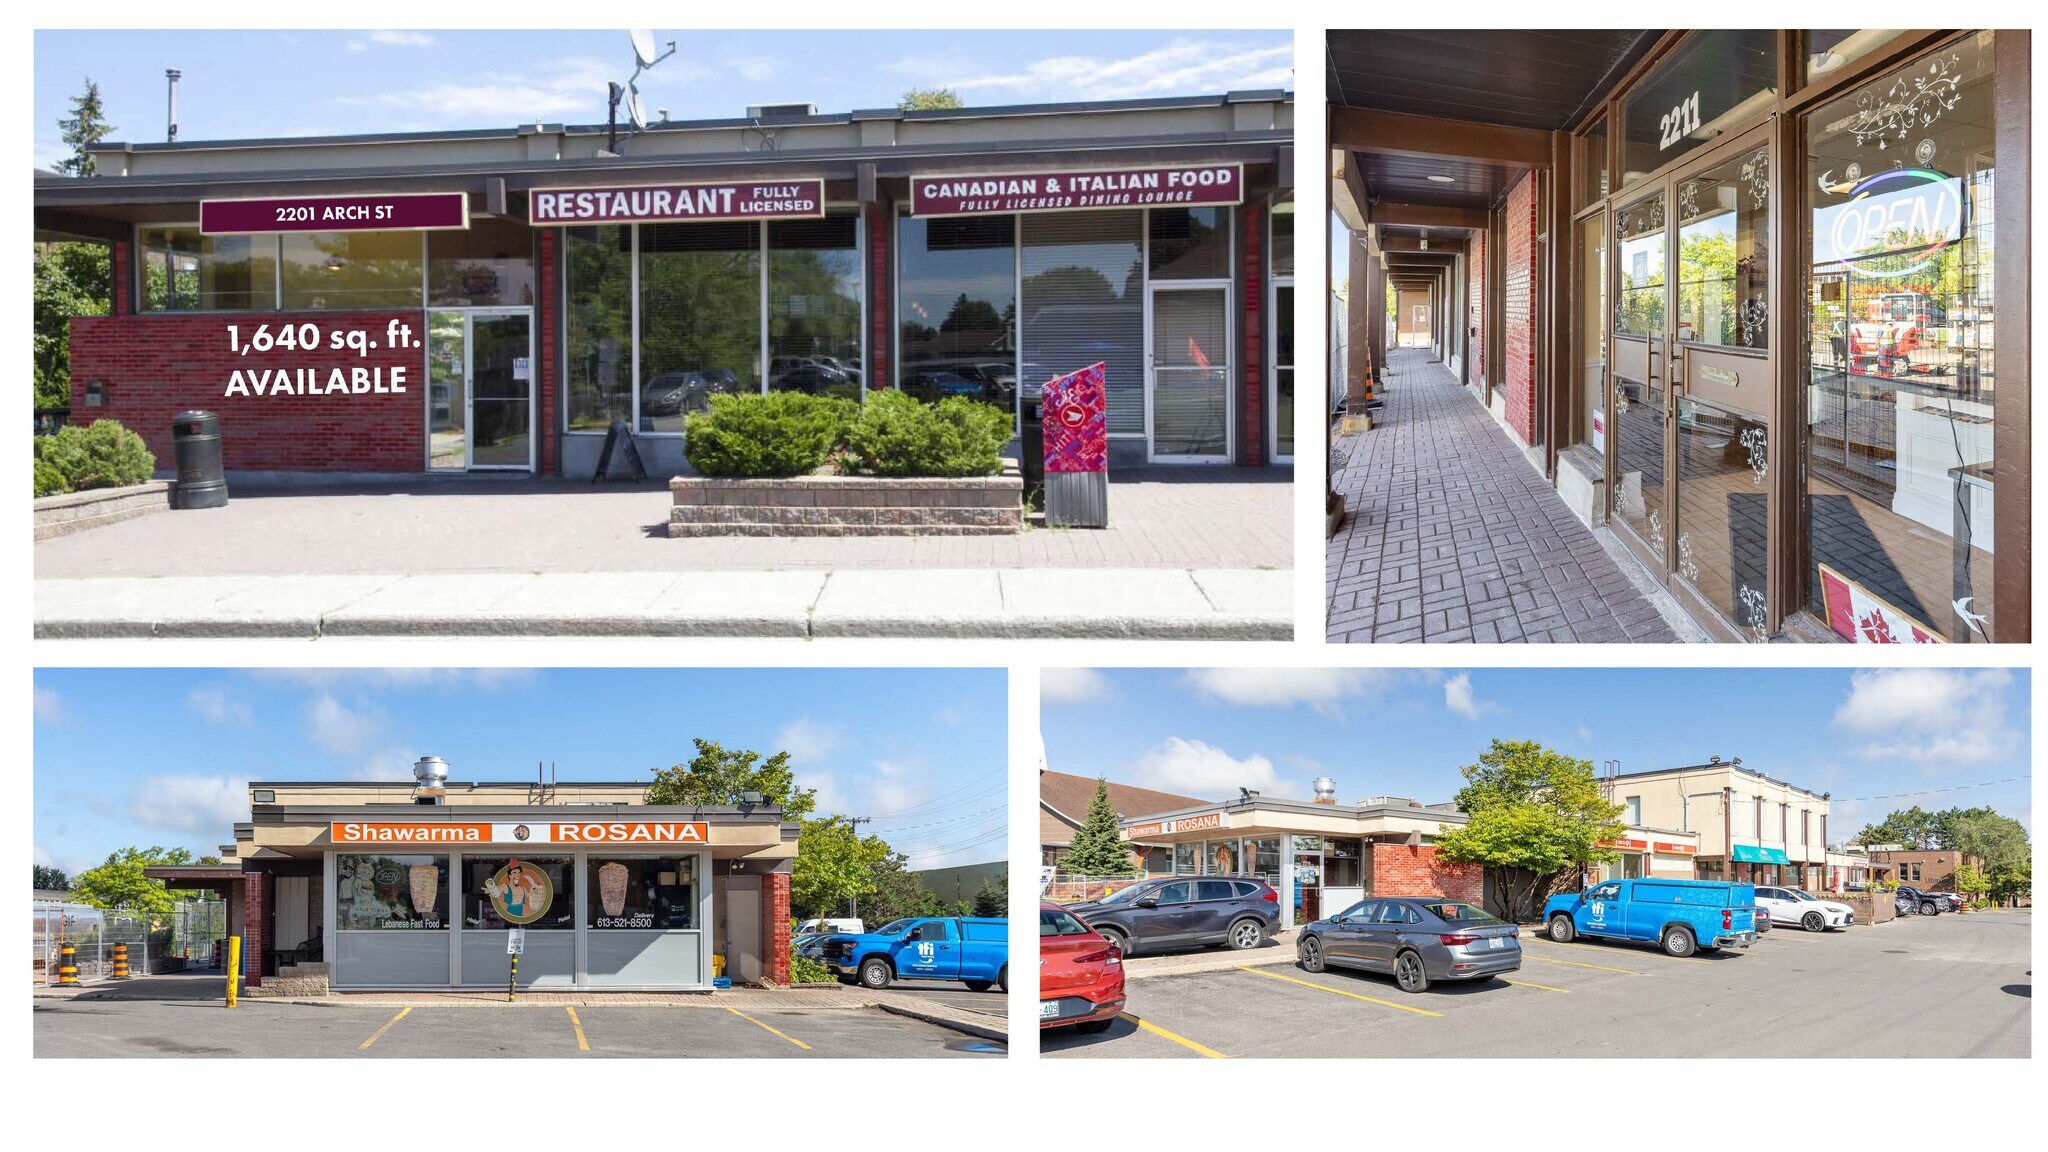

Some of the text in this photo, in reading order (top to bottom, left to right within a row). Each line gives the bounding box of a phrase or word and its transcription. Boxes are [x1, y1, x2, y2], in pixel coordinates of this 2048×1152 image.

[1660, 91, 1700, 151] 2211
[753, 186, 800, 198] FULLY
[924, 169, 1232, 199] CANADIAN & ITALIAN FOOD
[537, 188, 736, 219] RESTAURANT
[740, 200, 814, 213] LICENSED
[959, 191, 1194, 211] FULLY LICENSED DINING LOUNGE
[276, 205, 394, 222] 2201 ARCH ST
[1836, 191, 1946, 251] OPEN
[344, 823, 702, 841] Shawarma ROSANA
[1129, 816, 1219, 837] Shawarma ROSANA
[381, 919, 440, 929] Lebanese Fast Food
[597, 917, 652, 928] 613-521-8500
